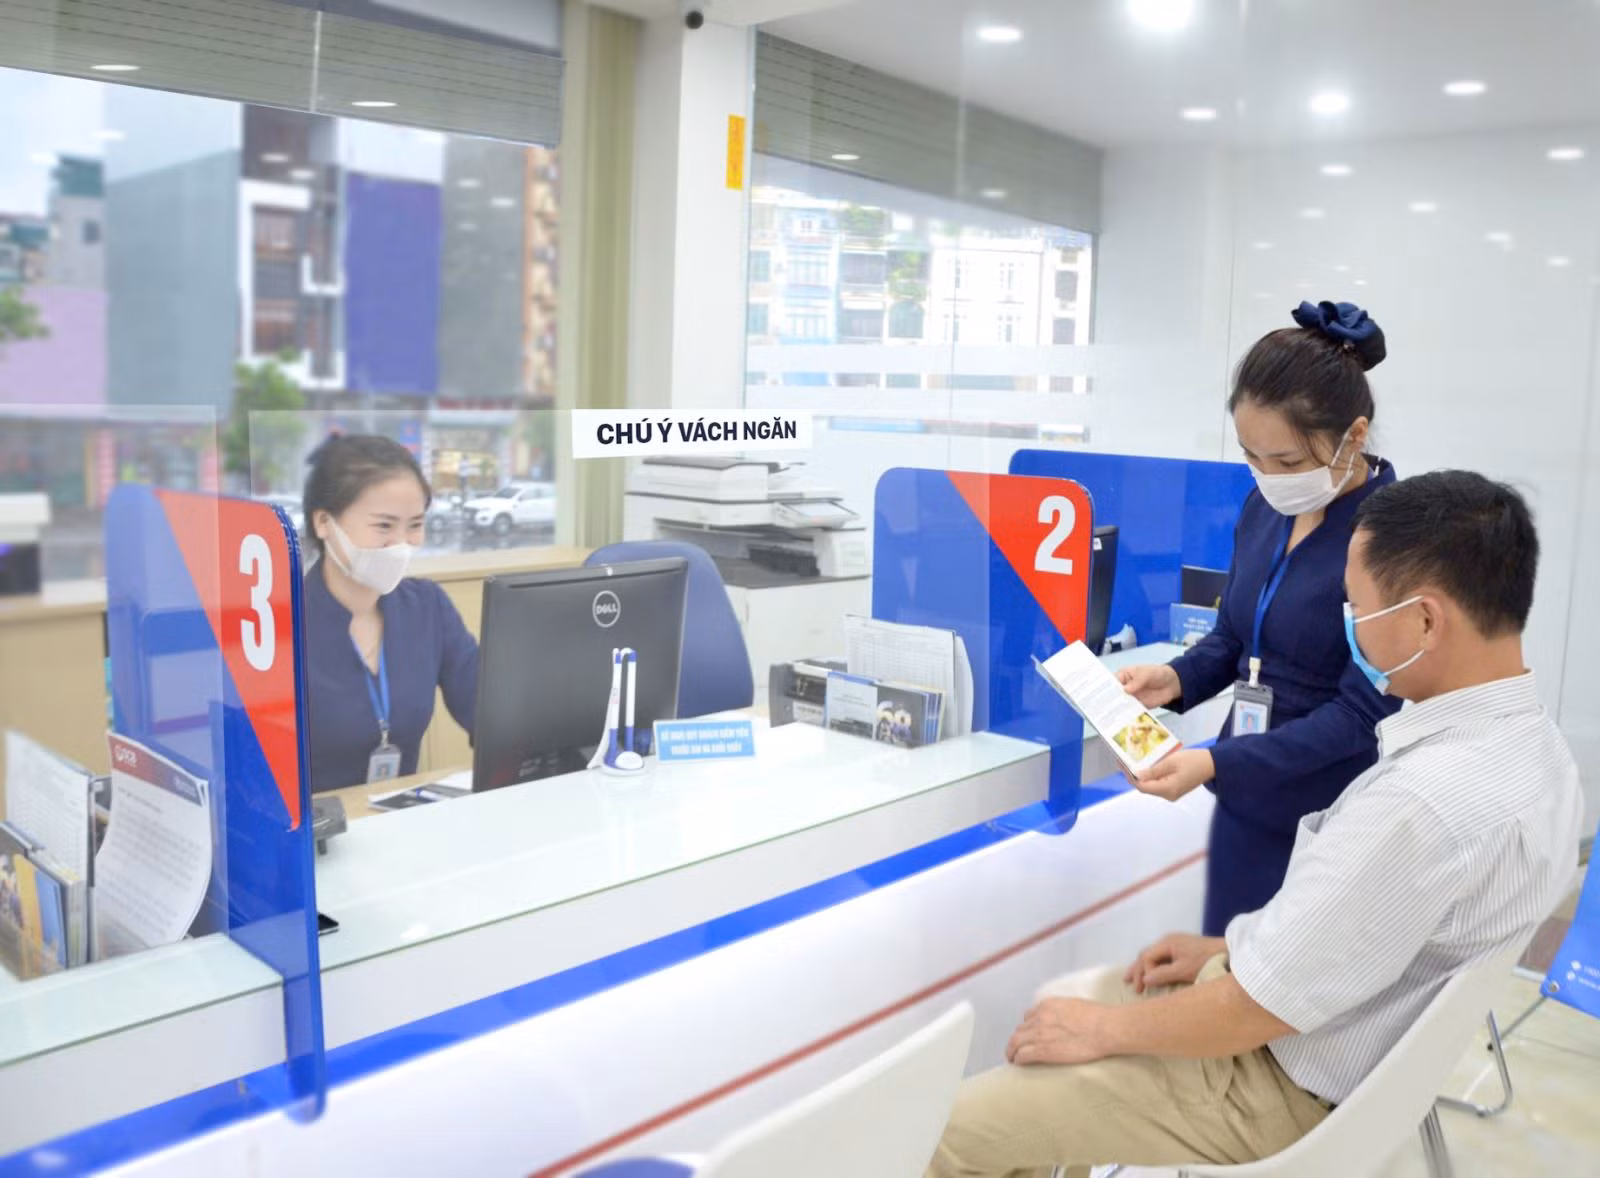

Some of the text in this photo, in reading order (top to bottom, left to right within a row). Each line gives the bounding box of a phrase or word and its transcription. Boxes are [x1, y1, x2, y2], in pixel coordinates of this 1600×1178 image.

[596, 417, 797, 445] CHÚ Ý VÁCH NGĂN
[1034, 495, 1076, 575] 2
[238, 533, 276, 672] 3
[596, 603, 618, 615] DELL
